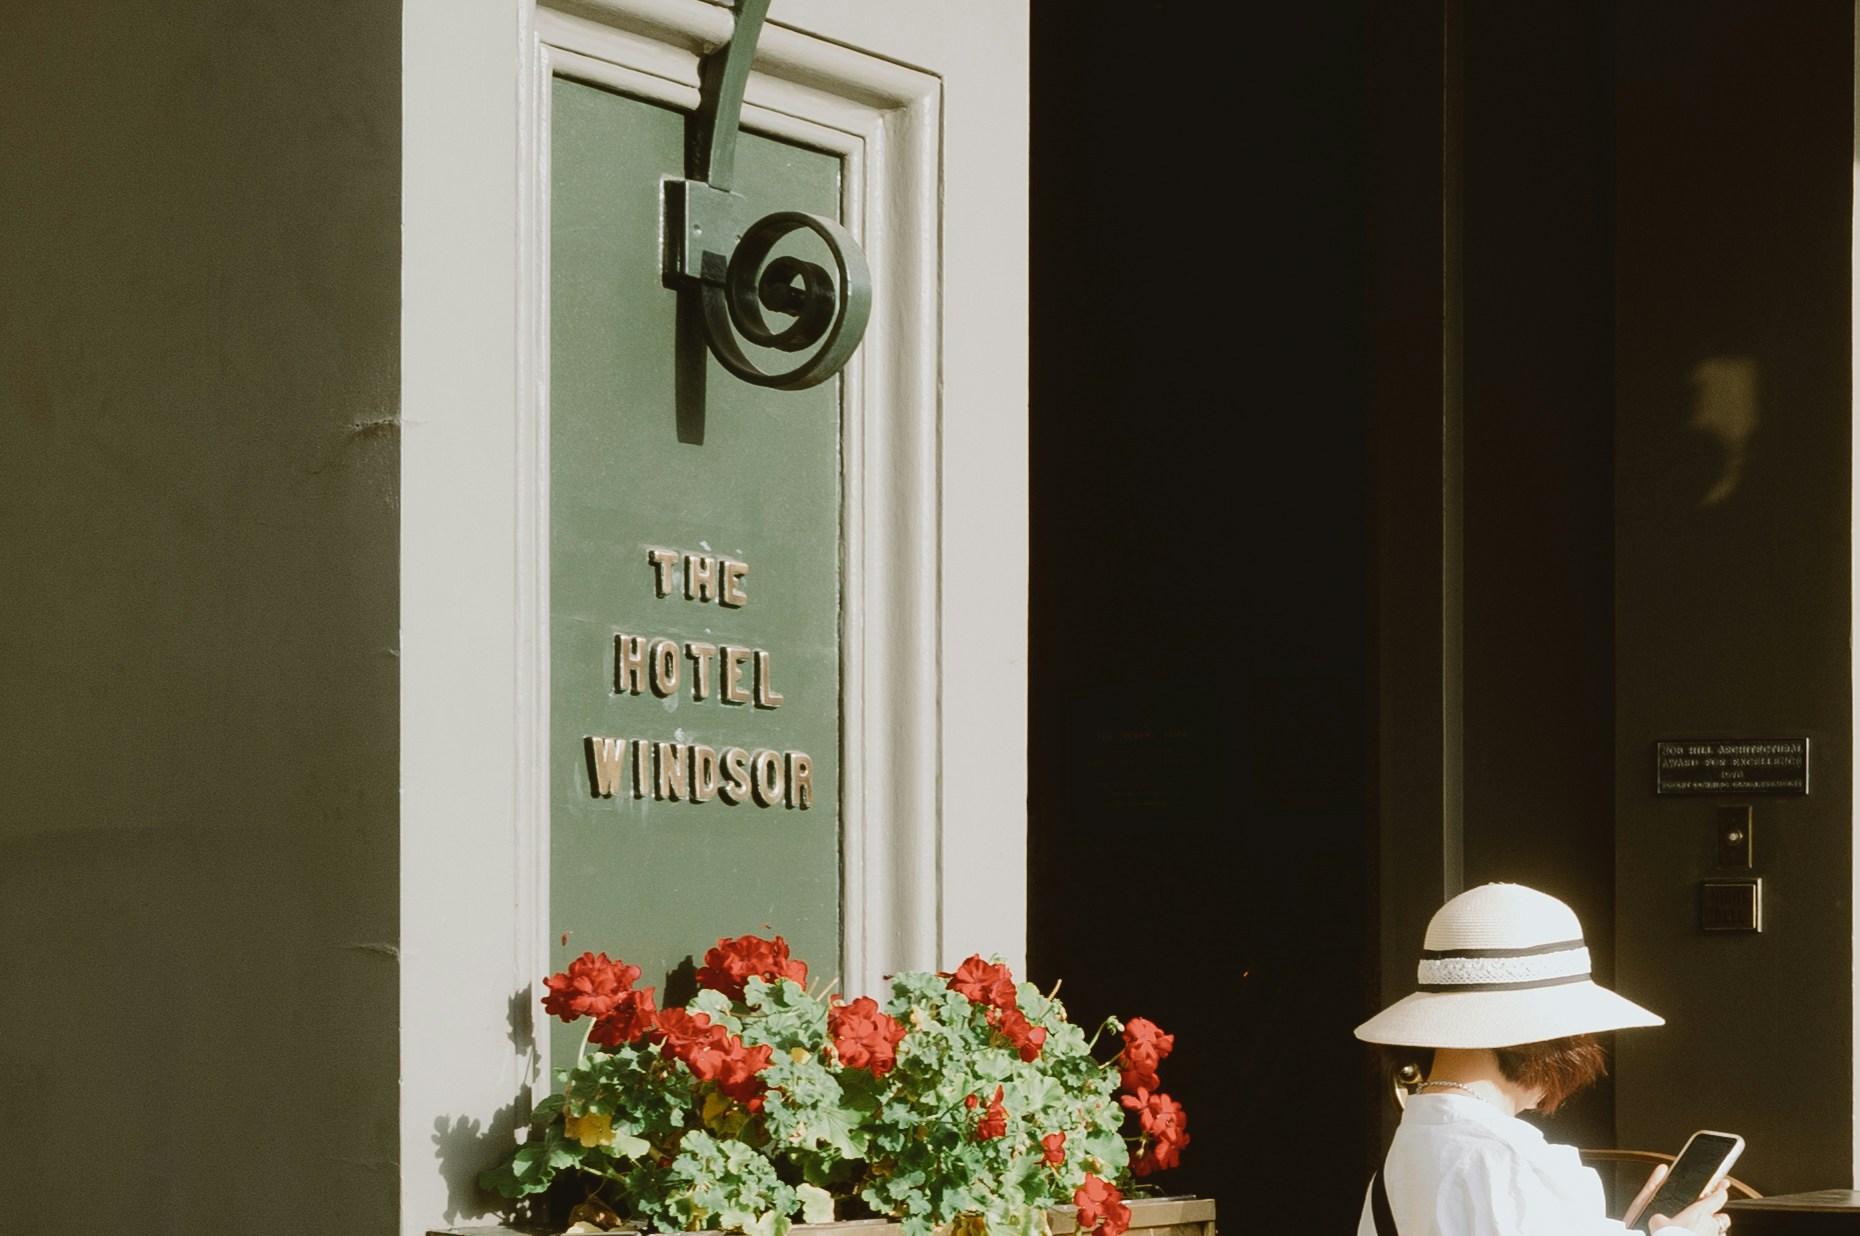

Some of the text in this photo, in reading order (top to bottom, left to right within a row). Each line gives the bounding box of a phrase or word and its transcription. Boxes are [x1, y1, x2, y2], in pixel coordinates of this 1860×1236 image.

[648, 550, 748, 608] THE
[614, 633, 784, 709] HOTEL
[584, 736, 813, 810] WINDSOR
[1733, 757, 1802, 767] EXCELLENCE
